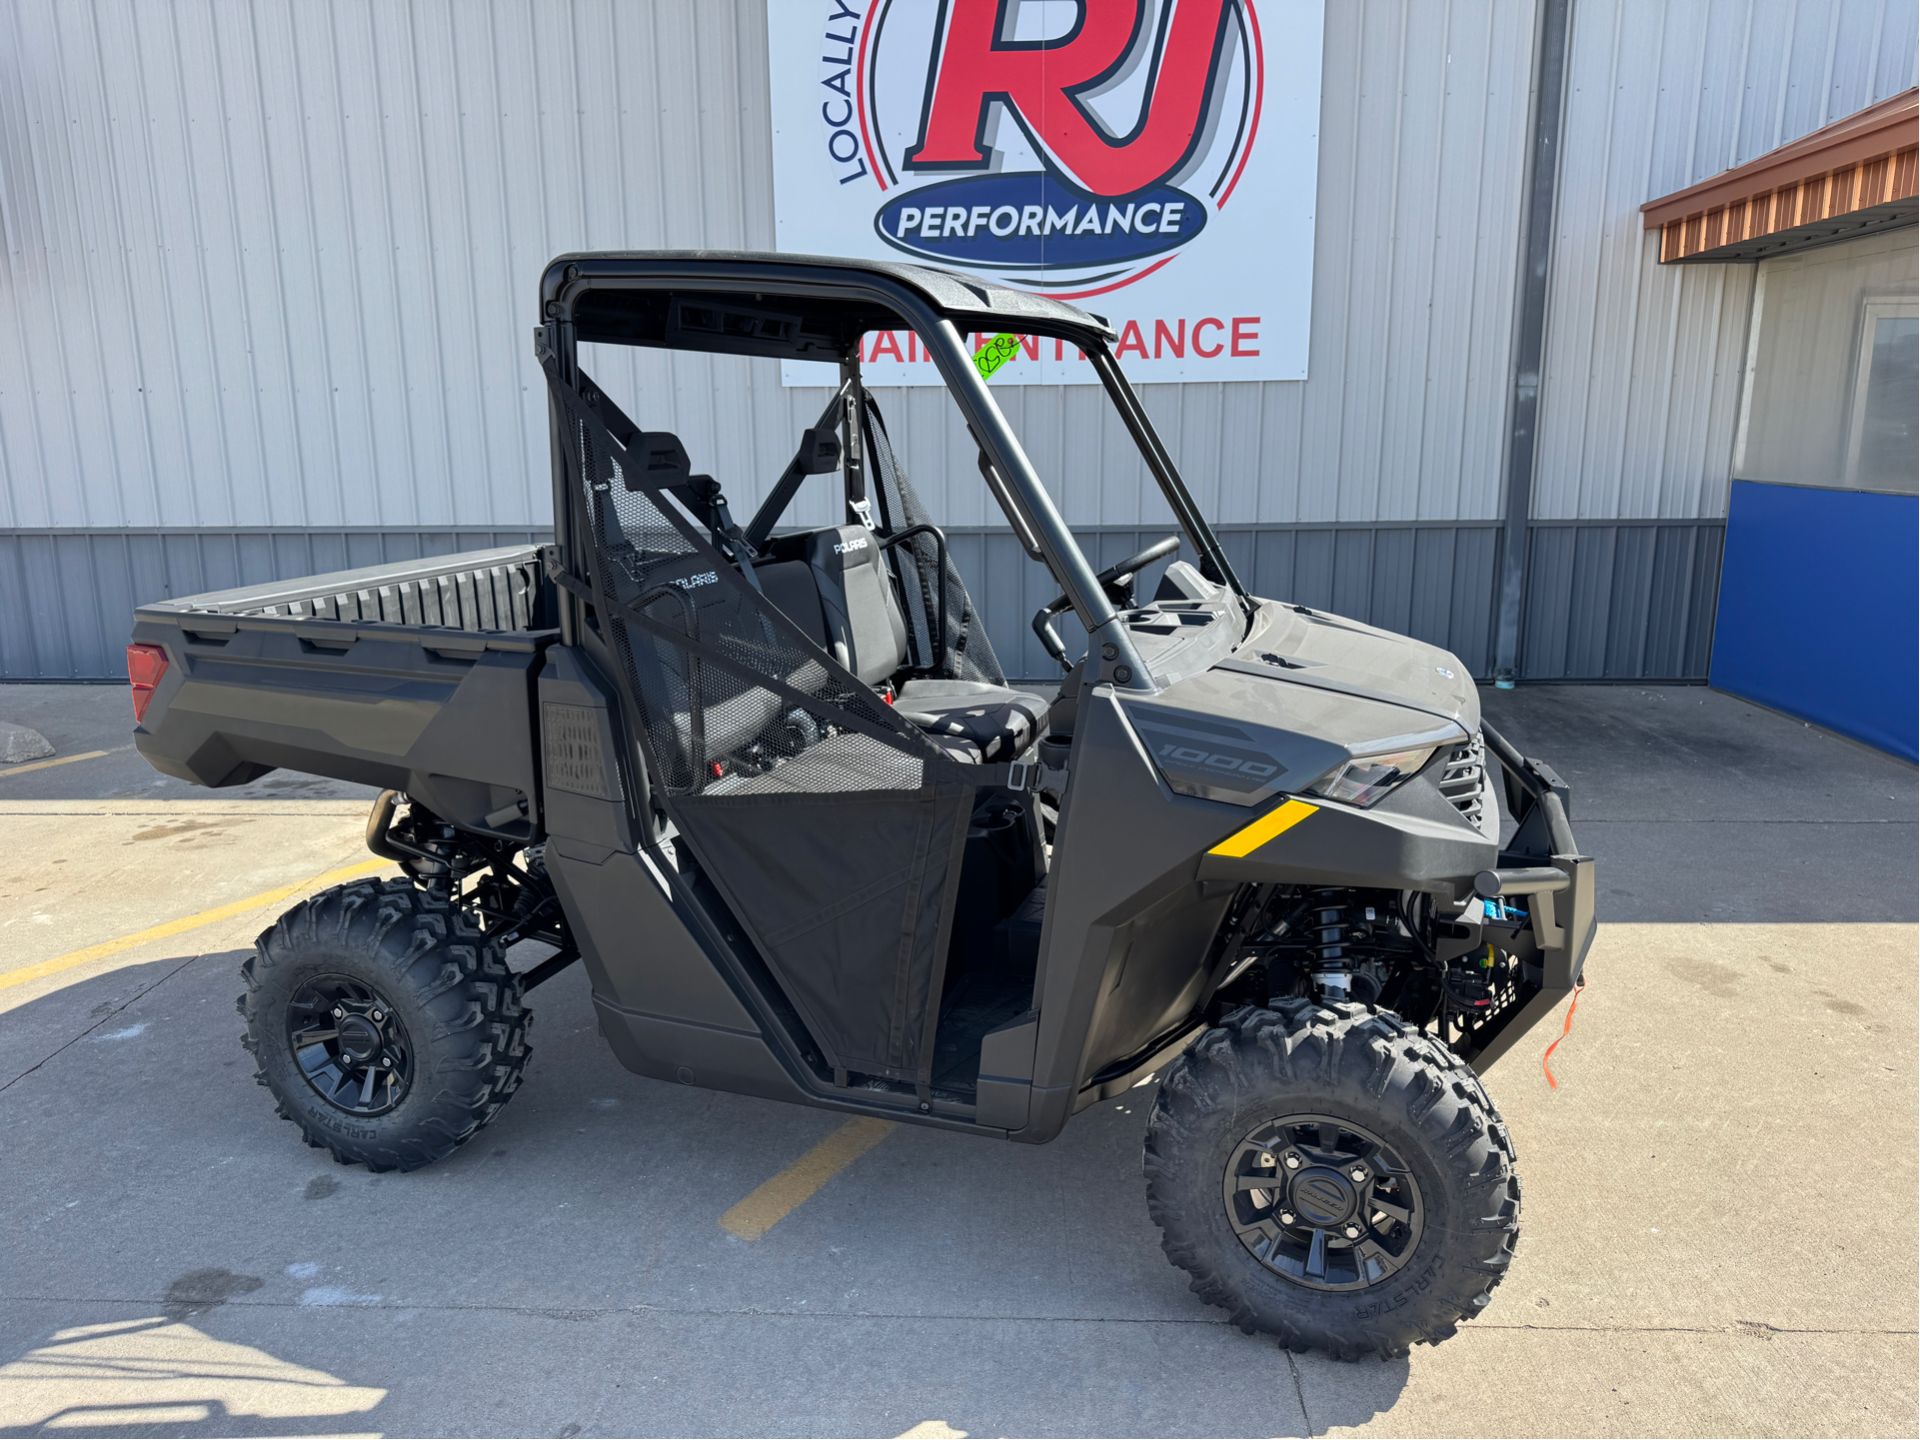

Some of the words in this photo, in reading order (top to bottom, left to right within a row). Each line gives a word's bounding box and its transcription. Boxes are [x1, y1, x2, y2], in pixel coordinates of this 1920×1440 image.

[821, 0, 868, 185] LOCALLY
[896, 202, 1185, 238] PERFORMANCE
[859, 329, 932, 363] AI
[833, 537, 868, 555] POLARIS
[669, 571, 719, 590] OLARIS
[1159, 744, 1278, 777] 1000
